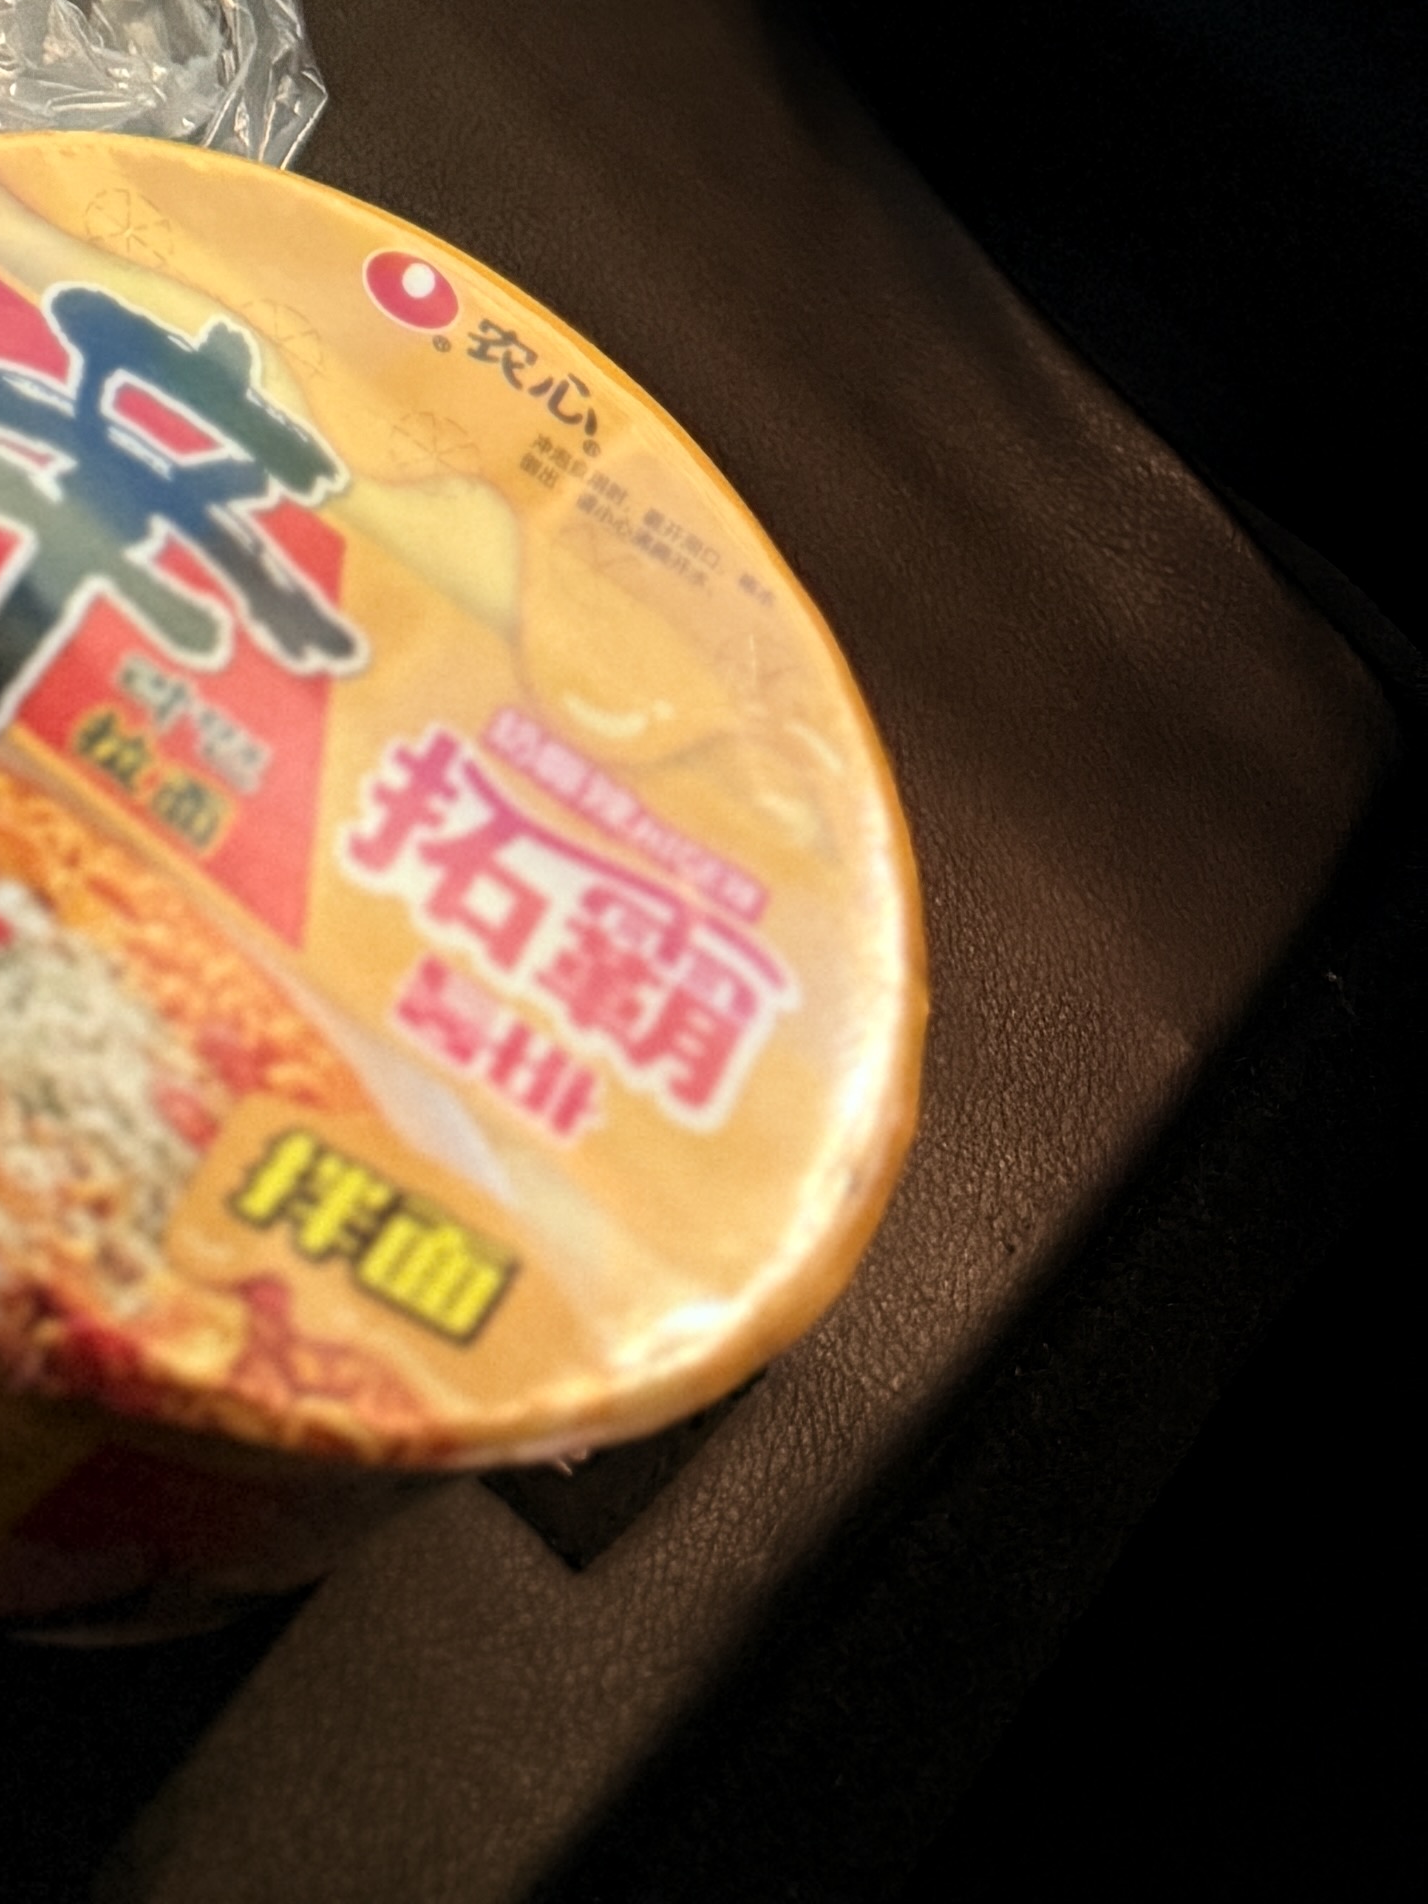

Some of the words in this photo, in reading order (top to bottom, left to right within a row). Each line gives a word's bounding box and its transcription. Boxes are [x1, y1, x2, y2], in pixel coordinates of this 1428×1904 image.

[466, 316, 600, 437] 农心
[349, 729, 794, 1114] 拓霸
[231, 1127, 520, 1344] 拌面
